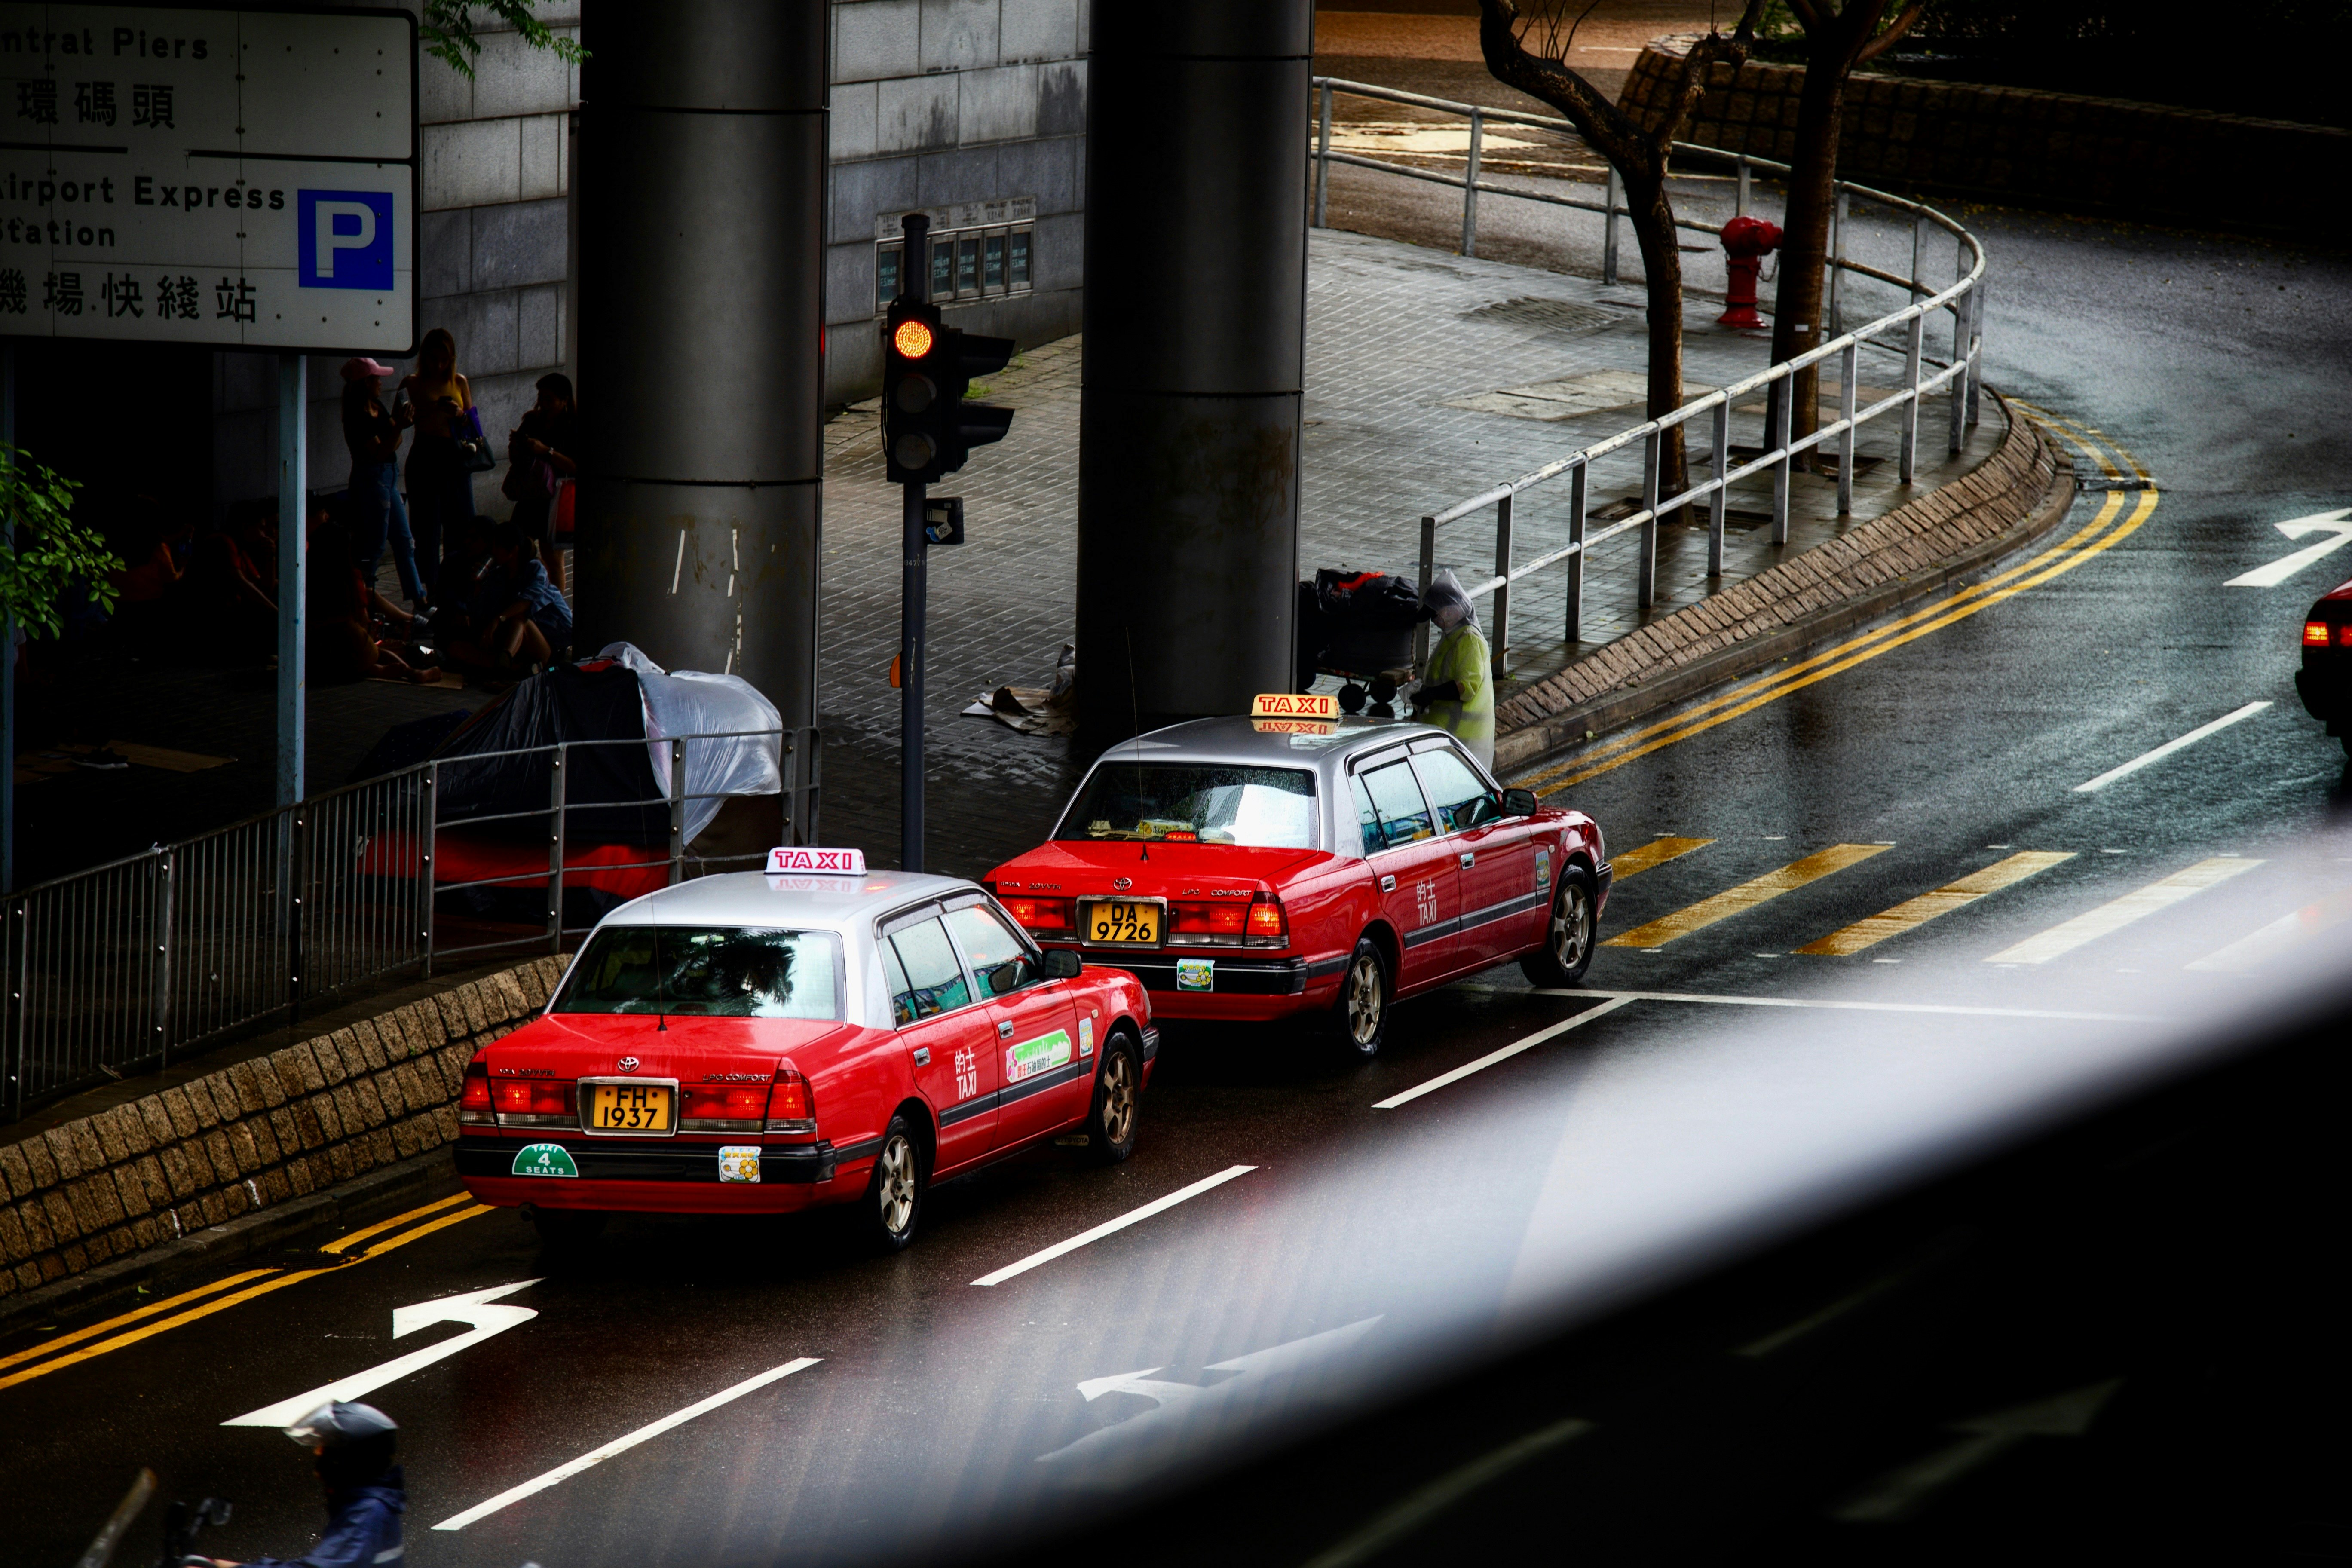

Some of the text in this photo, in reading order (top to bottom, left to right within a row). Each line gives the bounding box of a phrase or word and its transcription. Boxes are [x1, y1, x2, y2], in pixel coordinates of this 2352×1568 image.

[113, 27, 208, 60] Piers
[17, 80, 175, 130] 環碼頭
[0, 173, 285, 212] irport Express
[0, 218, 115, 247] tation
[315, 200, 376, 279] P
[1259, 697, 1328, 714] TAXI
[775, 851, 852, 870] TAXI
[1416, 877, 1436, 903] 的士
[1111, 904, 1137, 922] DA
[1418, 899, 1436, 927] TAXI
[1097, 921, 1151, 941] 9726
[954, 1046, 976, 1075] 的士
[725, 1073, 771, 1081] COMFORT
[956, 1070, 977, 1100] TAXI
[616, 1087, 647, 1108] FH
[603, 1106, 658, 1128] 1937
[531, 1145, 559, 1154] TAXI
[538, 1152, 551, 1166] 4
[526, 1166, 564, 1175] SEATS
